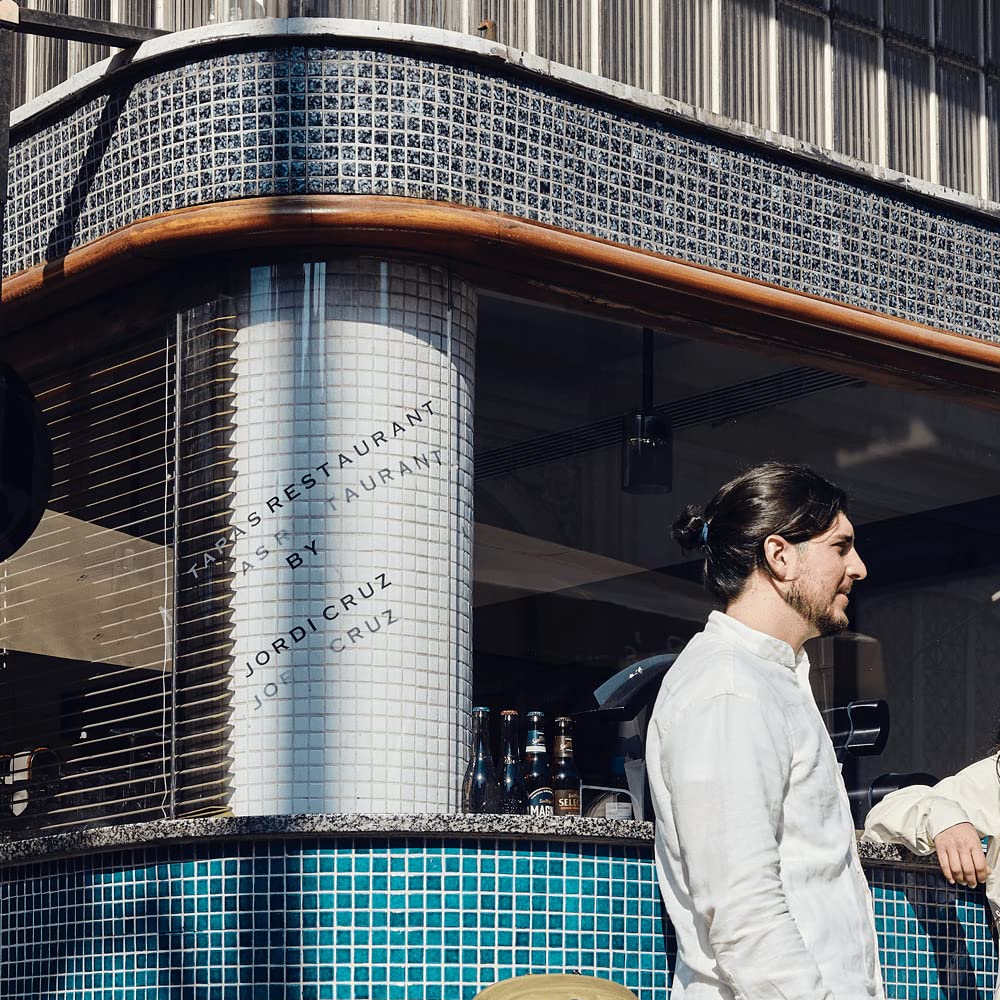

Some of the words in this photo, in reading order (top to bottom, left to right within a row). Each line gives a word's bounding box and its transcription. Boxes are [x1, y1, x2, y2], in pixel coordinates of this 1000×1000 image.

[188, 512, 262, 580] TAPAS
[266, 400, 436, 514] RESTAURANT
[286, 539, 319, 570] BY
[244, 617, 317, 678] JORDI
[322, 573, 393, 621] CRUZ
[558, 798, 580, 807] SELE
